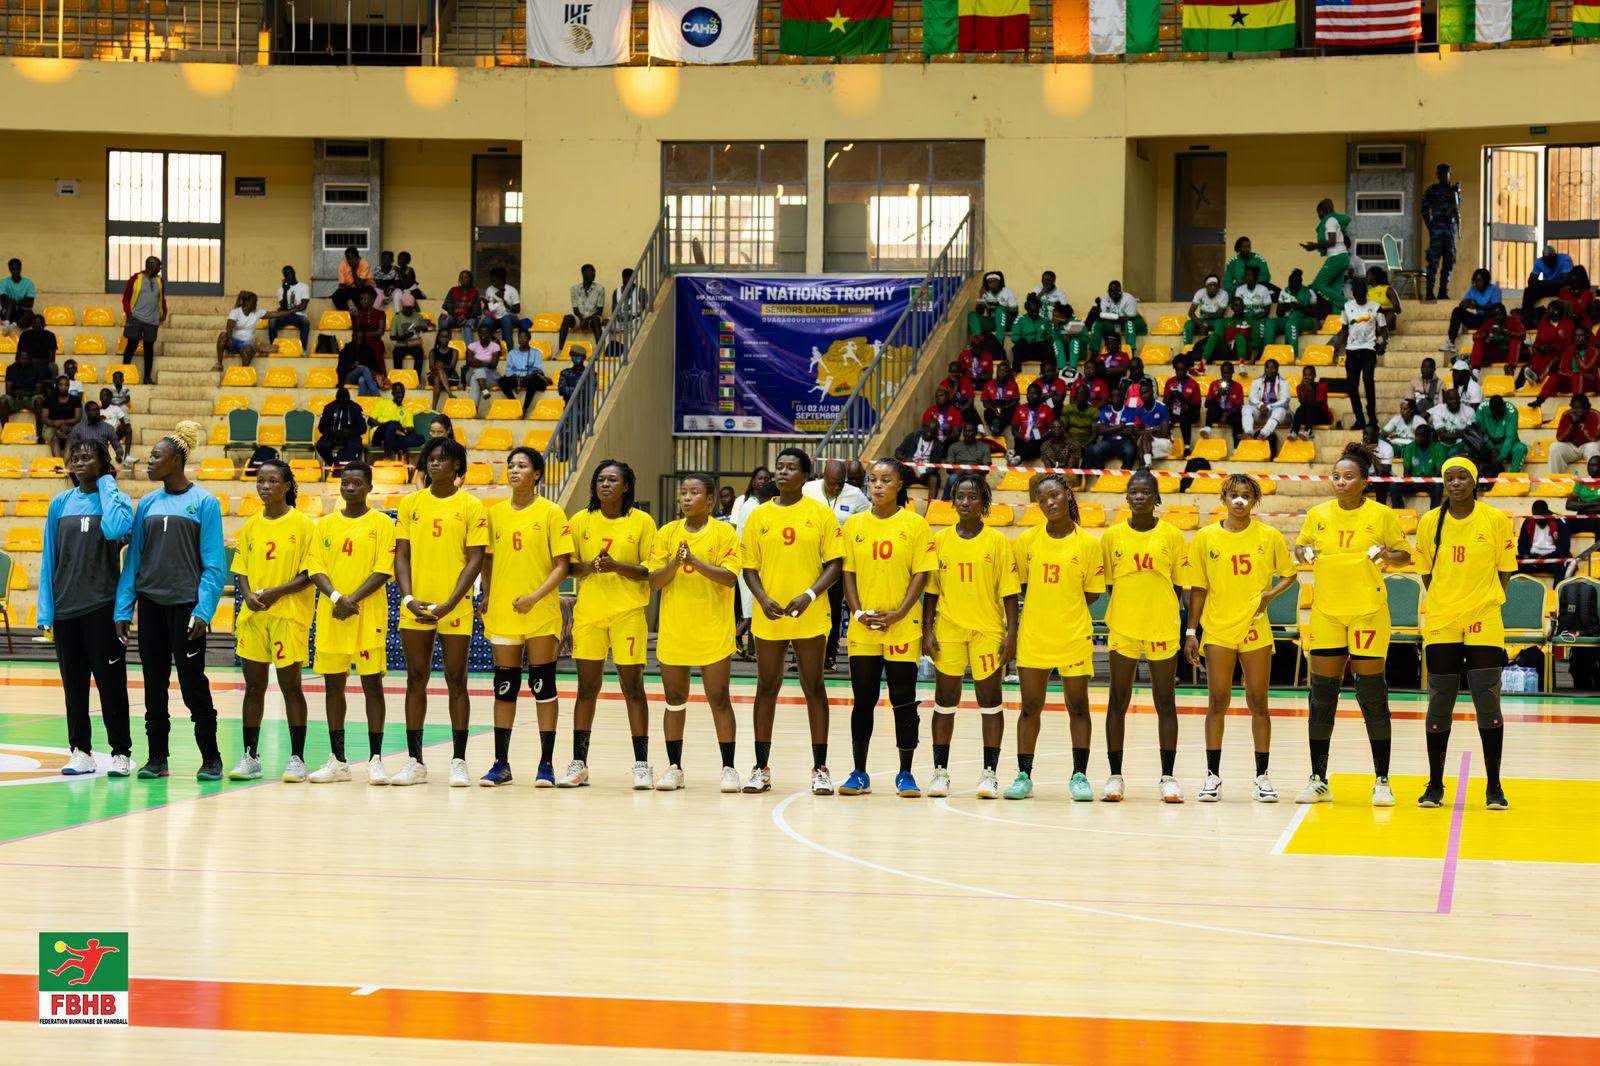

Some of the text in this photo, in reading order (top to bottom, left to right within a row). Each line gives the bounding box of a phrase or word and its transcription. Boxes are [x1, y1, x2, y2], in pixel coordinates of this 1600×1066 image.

[564, 4, 593, 25] IHF
[683, 21, 719, 35] CAHB
[740, 286, 896, 301] IHF NATIONS TROPHY
[765, 305, 802, 314] SENIORS
[805, 305, 837, 314] DAMES
[795, 404, 840, 412] DU 02 AU 08
[163, 516, 168, 532] 1
[432, 518, 443, 538] 5
[512, 531, 522, 552] 6
[602, 538, 613, 553] 7
[782, 527, 796, 546] 9
[1338, 530, 1355, 548] 17
[265, 541, 276, 561] 2
[342, 537, 353, 557] 4
[872, 540, 893, 561] 10
[1452, 545, 1465, 563] 18
[1133, 553, 1153, 571] 14
[1231, 553, 1252, 576] 15
[958, 562, 974, 583] 11
[1043, 563, 1060, 584] 13
[626, 636, 635, 657] 7
[1354, 629, 1376, 650] 17
[274, 641, 285, 660] 2
[978, 653, 995, 673] 11
